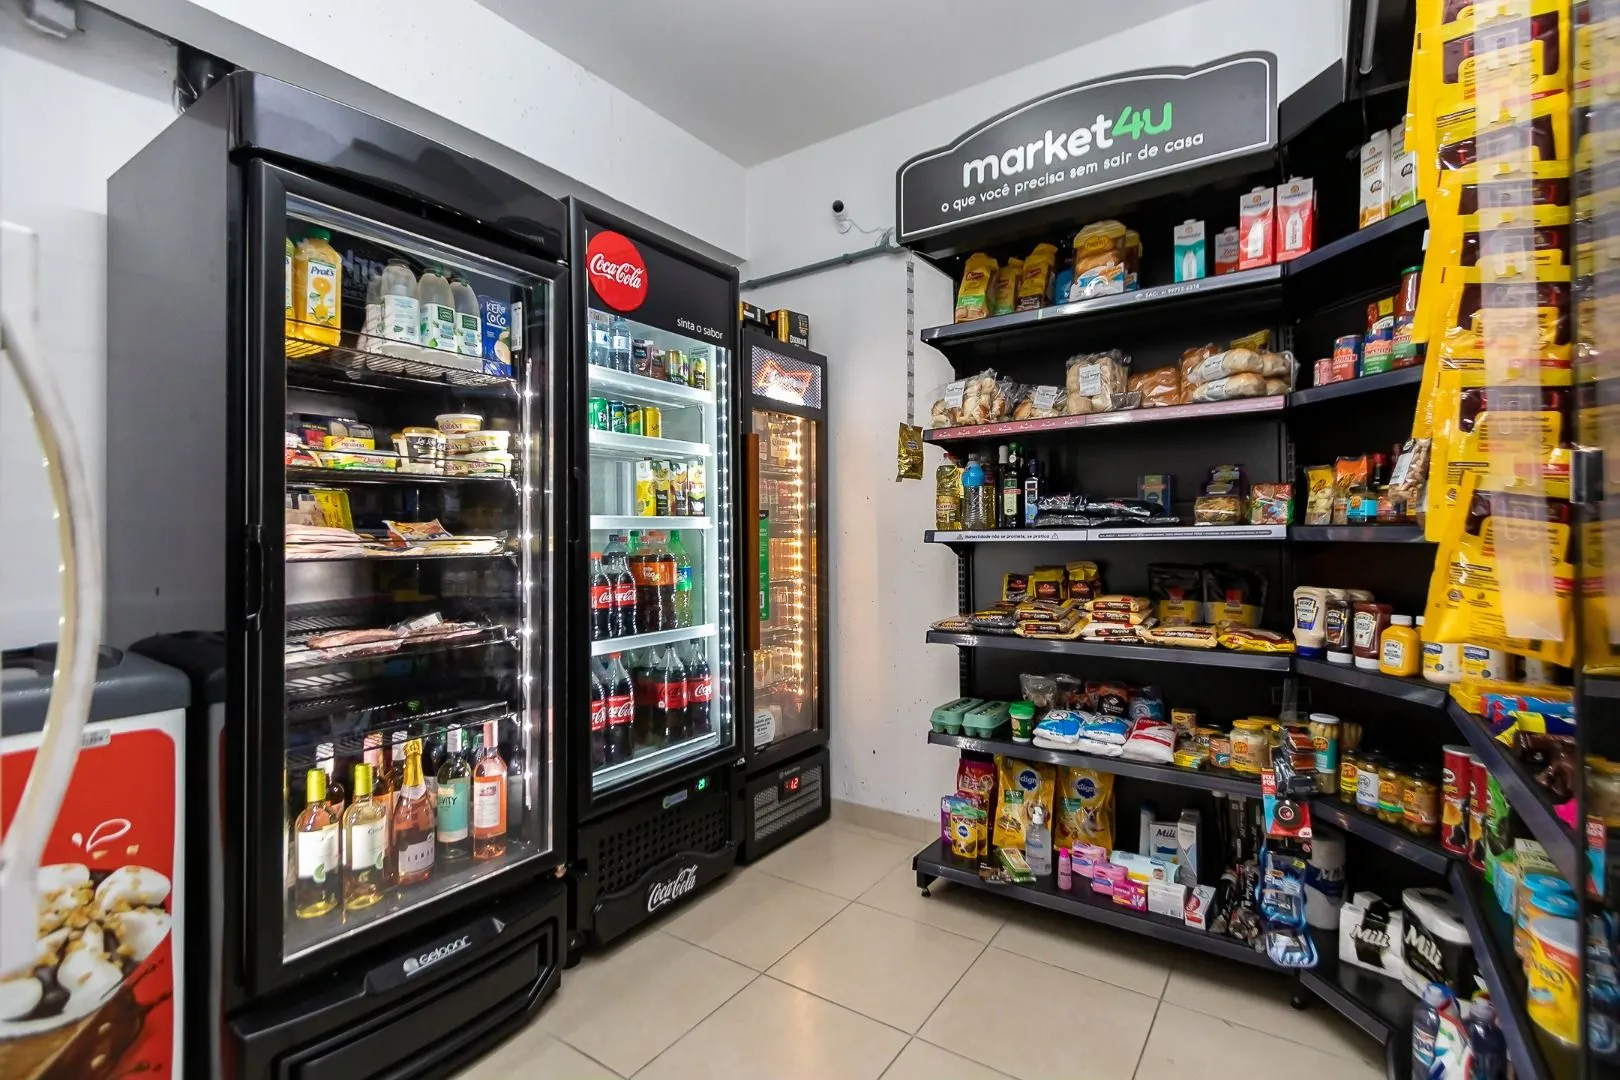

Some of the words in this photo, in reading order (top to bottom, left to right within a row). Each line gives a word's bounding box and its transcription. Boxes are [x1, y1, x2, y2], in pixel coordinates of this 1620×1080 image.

[941, 202, 949, 213] o
[953, 195, 976, 213] que
[979, 182, 1011, 203] você
[1014, 170, 1065, 197] precisa
[1069, 161, 1098, 179] sem
[1103, 151, 1132, 171] sair
[1137, 144, 1159, 162] de
[1164, 131, 1204, 154] casa
[310, 265, 334, 276] Prat's
[590, 253, 644, 290] Coca-Cola
[676, 317, 695, 332] sinta
[696, 324, 702, 334] o
[703, 325, 724, 340] sabor
[647, 864, 698, 913] Coca-Cola
[1349, 923, 1391, 948] Mili
[1404, 924, 1443, 970] Mili
